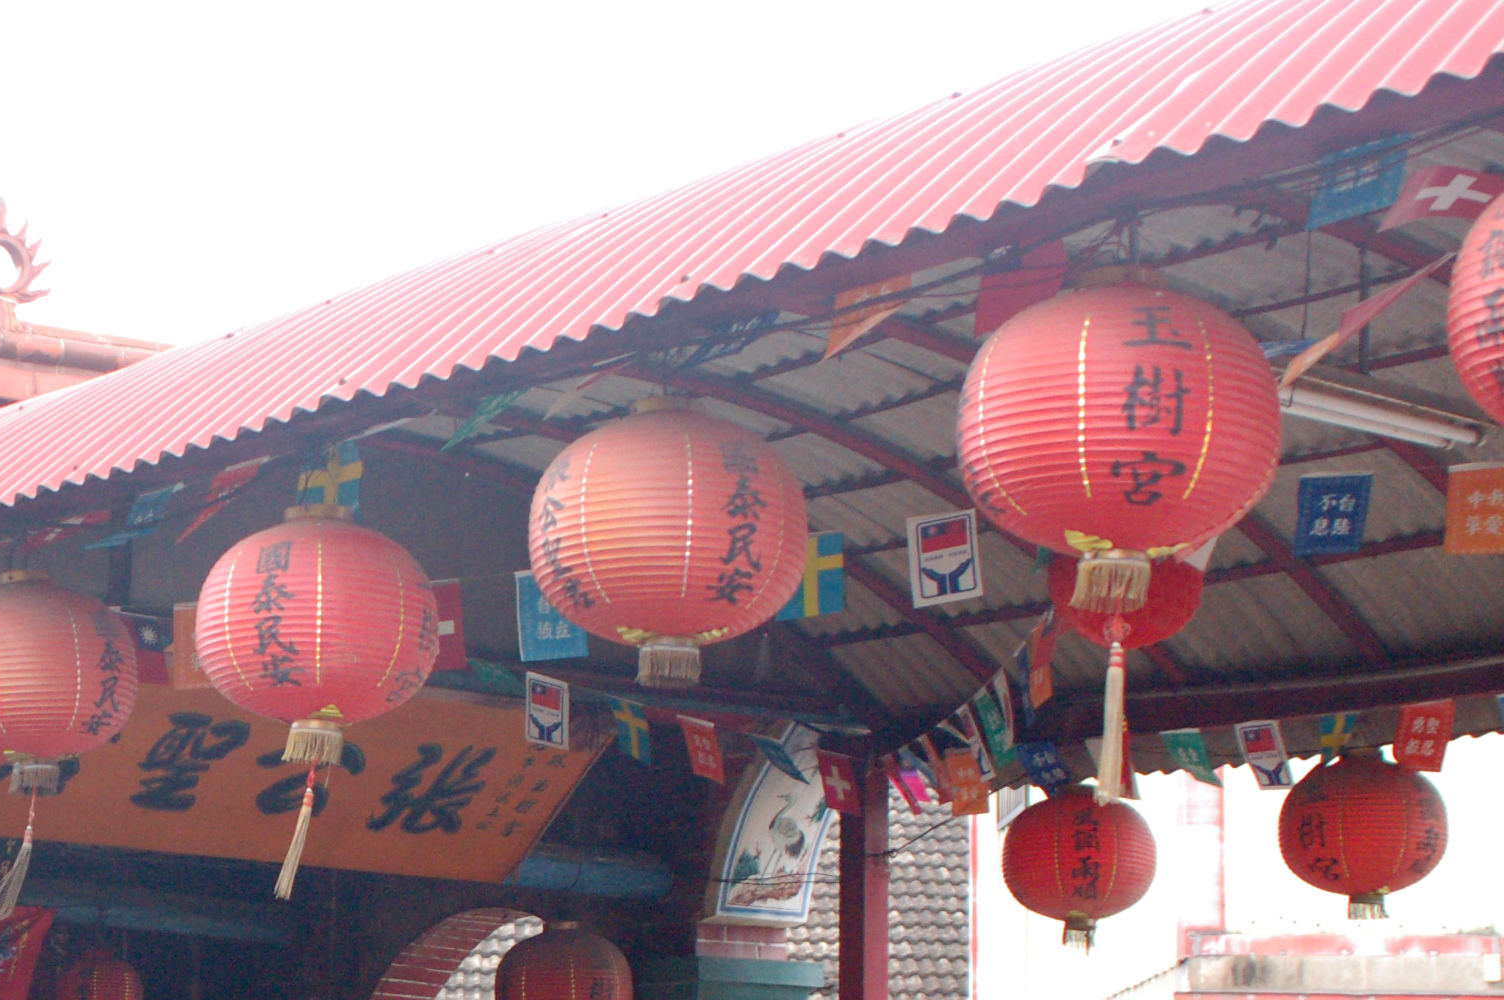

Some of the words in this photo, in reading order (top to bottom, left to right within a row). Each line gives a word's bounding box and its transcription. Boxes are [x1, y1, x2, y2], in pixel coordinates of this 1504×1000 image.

[1107, 305, 1193, 505] 玉樹宮
[250, 540, 306, 687] 國泰民安
